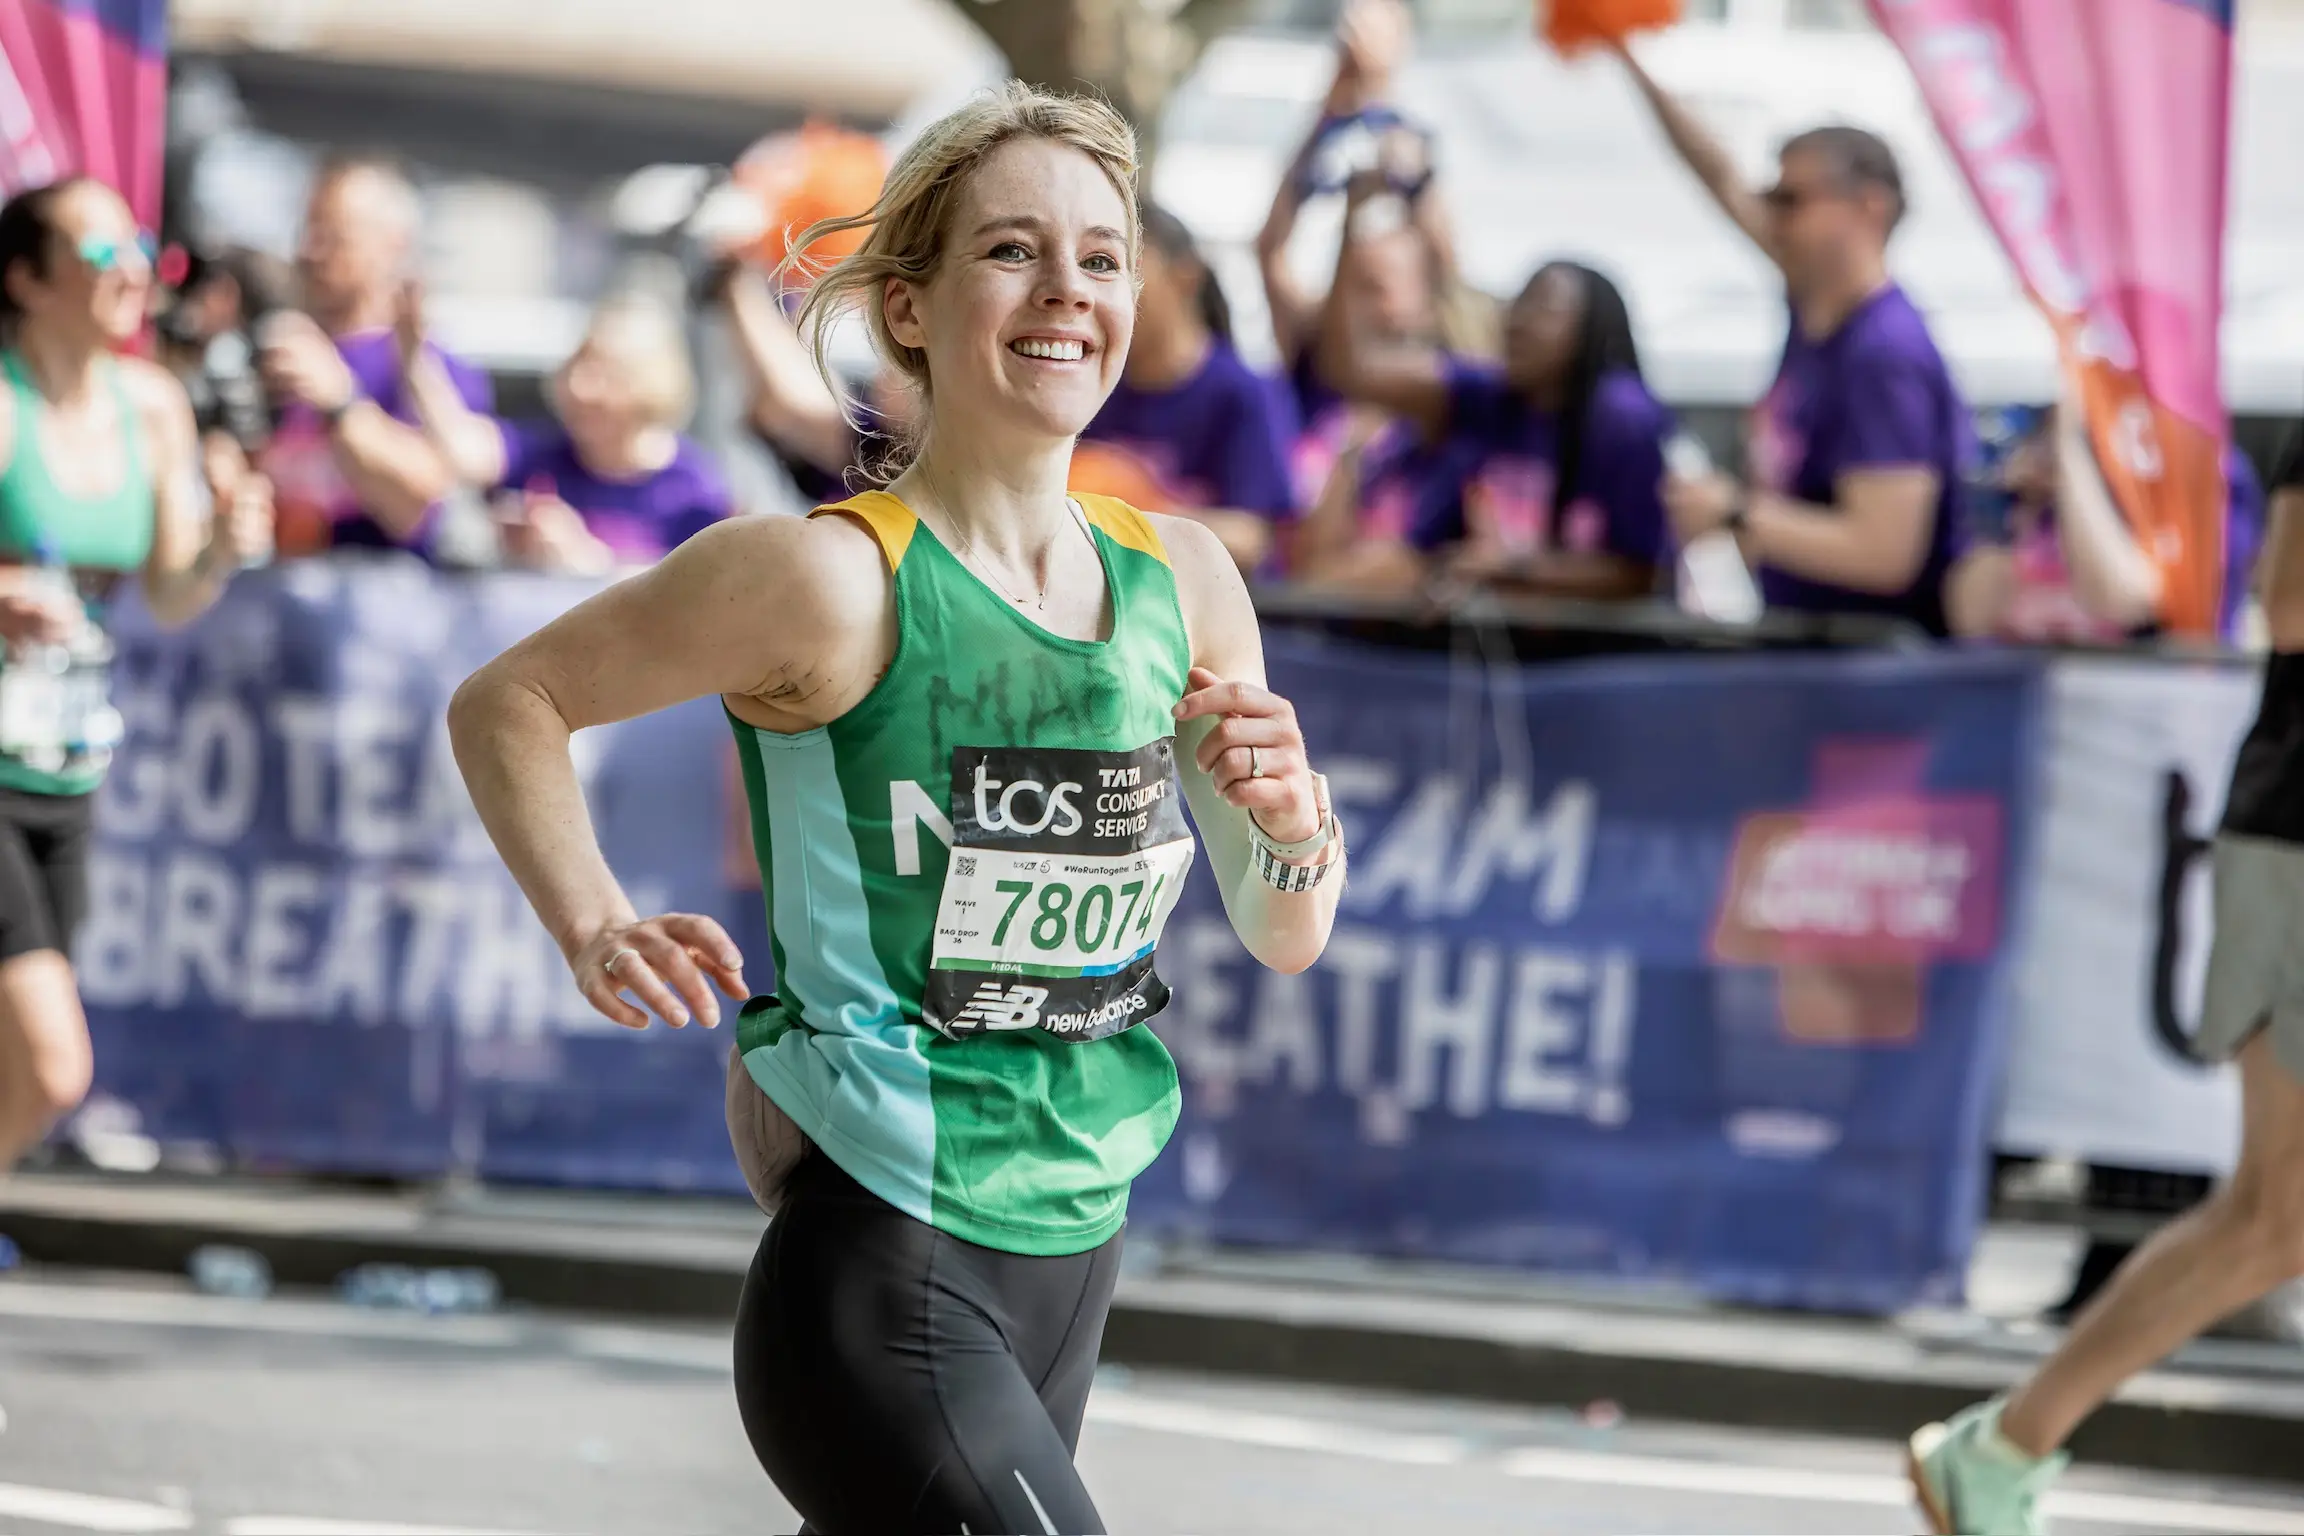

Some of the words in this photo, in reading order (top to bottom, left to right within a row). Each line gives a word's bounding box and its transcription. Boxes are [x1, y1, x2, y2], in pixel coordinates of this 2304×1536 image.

[104, 690, 260, 843] GO
[270, 698, 560, 858] TEA
[1098, 766, 1141, 788] TATA
[973, 764, 1083, 837] tcs
[1096, 778, 1165, 814] CONSULTANCY
[1093, 811, 1148, 838] SERVICES
[1305, 756, 1594, 922] EAM
[954, 899, 977, 908] WAVE
[991, 874, 1165, 954] 78074
[74, 848, 668, 1042] BREATH
[939, 928, 956, 936] BAG
[957, 929, 979, 938] DROP
[991, 962, 1023, 973] MEDAL
[1086, 993, 1148, 1029] balance
[1164, 914, 1638, 1126] EATHE!
